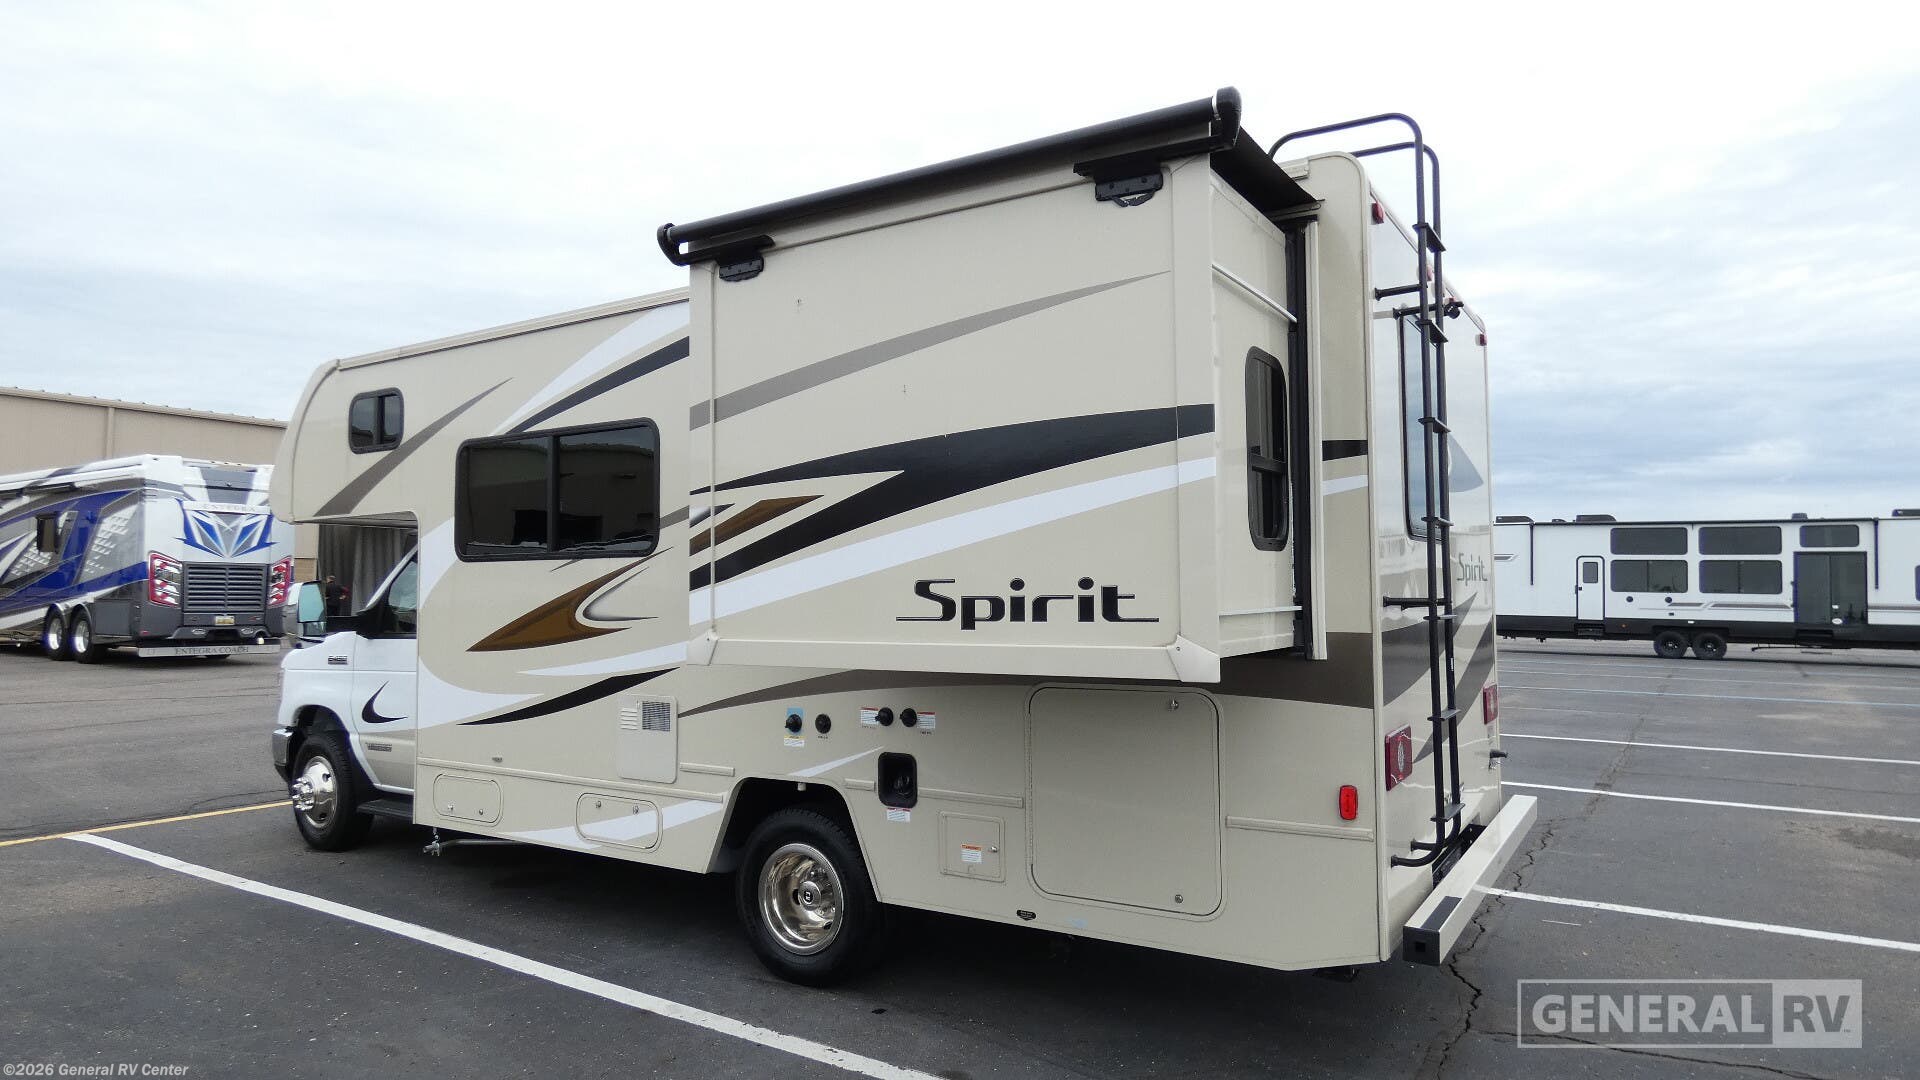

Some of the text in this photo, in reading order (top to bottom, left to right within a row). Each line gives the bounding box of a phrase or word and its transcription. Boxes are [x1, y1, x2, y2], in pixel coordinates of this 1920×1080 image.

[1456, 552, 1488, 587] Spirit
[896, 577, 1160, 630] Spirit
[175, 646, 249, 656] ENTEGRA COACH
